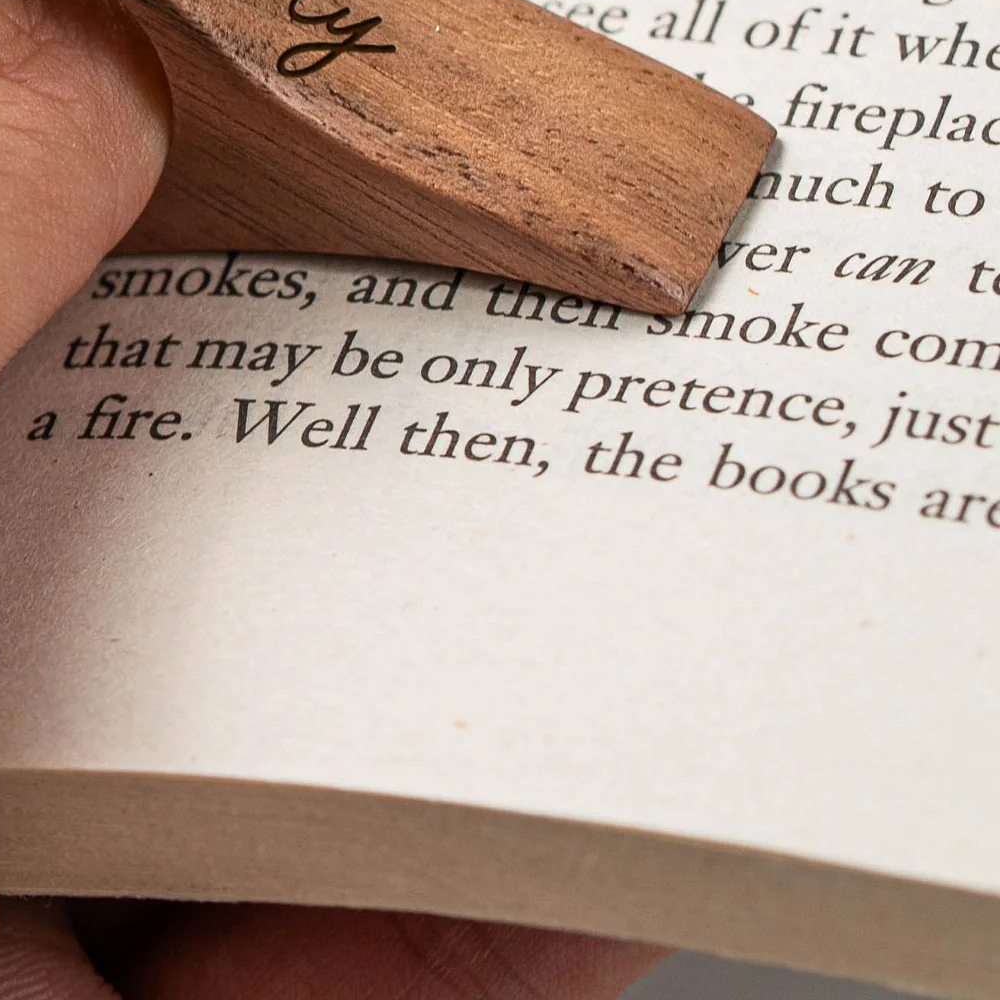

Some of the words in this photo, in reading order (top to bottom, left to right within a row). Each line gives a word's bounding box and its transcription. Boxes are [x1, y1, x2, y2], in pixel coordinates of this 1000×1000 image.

[745, 8, 822, 50] of
[827, 13, 873, 57] it
[925, 182, 985, 217] to
[91, 251, 318, 311] smokes,
[346, 265, 468, 313] and
[834, 253, 935, 285] can
[63, 323, 181, 370] that
[186, 339, 322, 387] may
[332, 330, 403, 379] be
[421, 346, 562, 406] only
[564, 371, 856, 437] pretence,
[876, 391, 1000, 448] just
[27, 411, 57, 441] a
[77, 393, 192, 441] fire.
[234, 398, 381, 450] Well
[400, 412, 549, 476] then,
[585, 432, 682, 481] the
[709, 443, 895, 509] books
